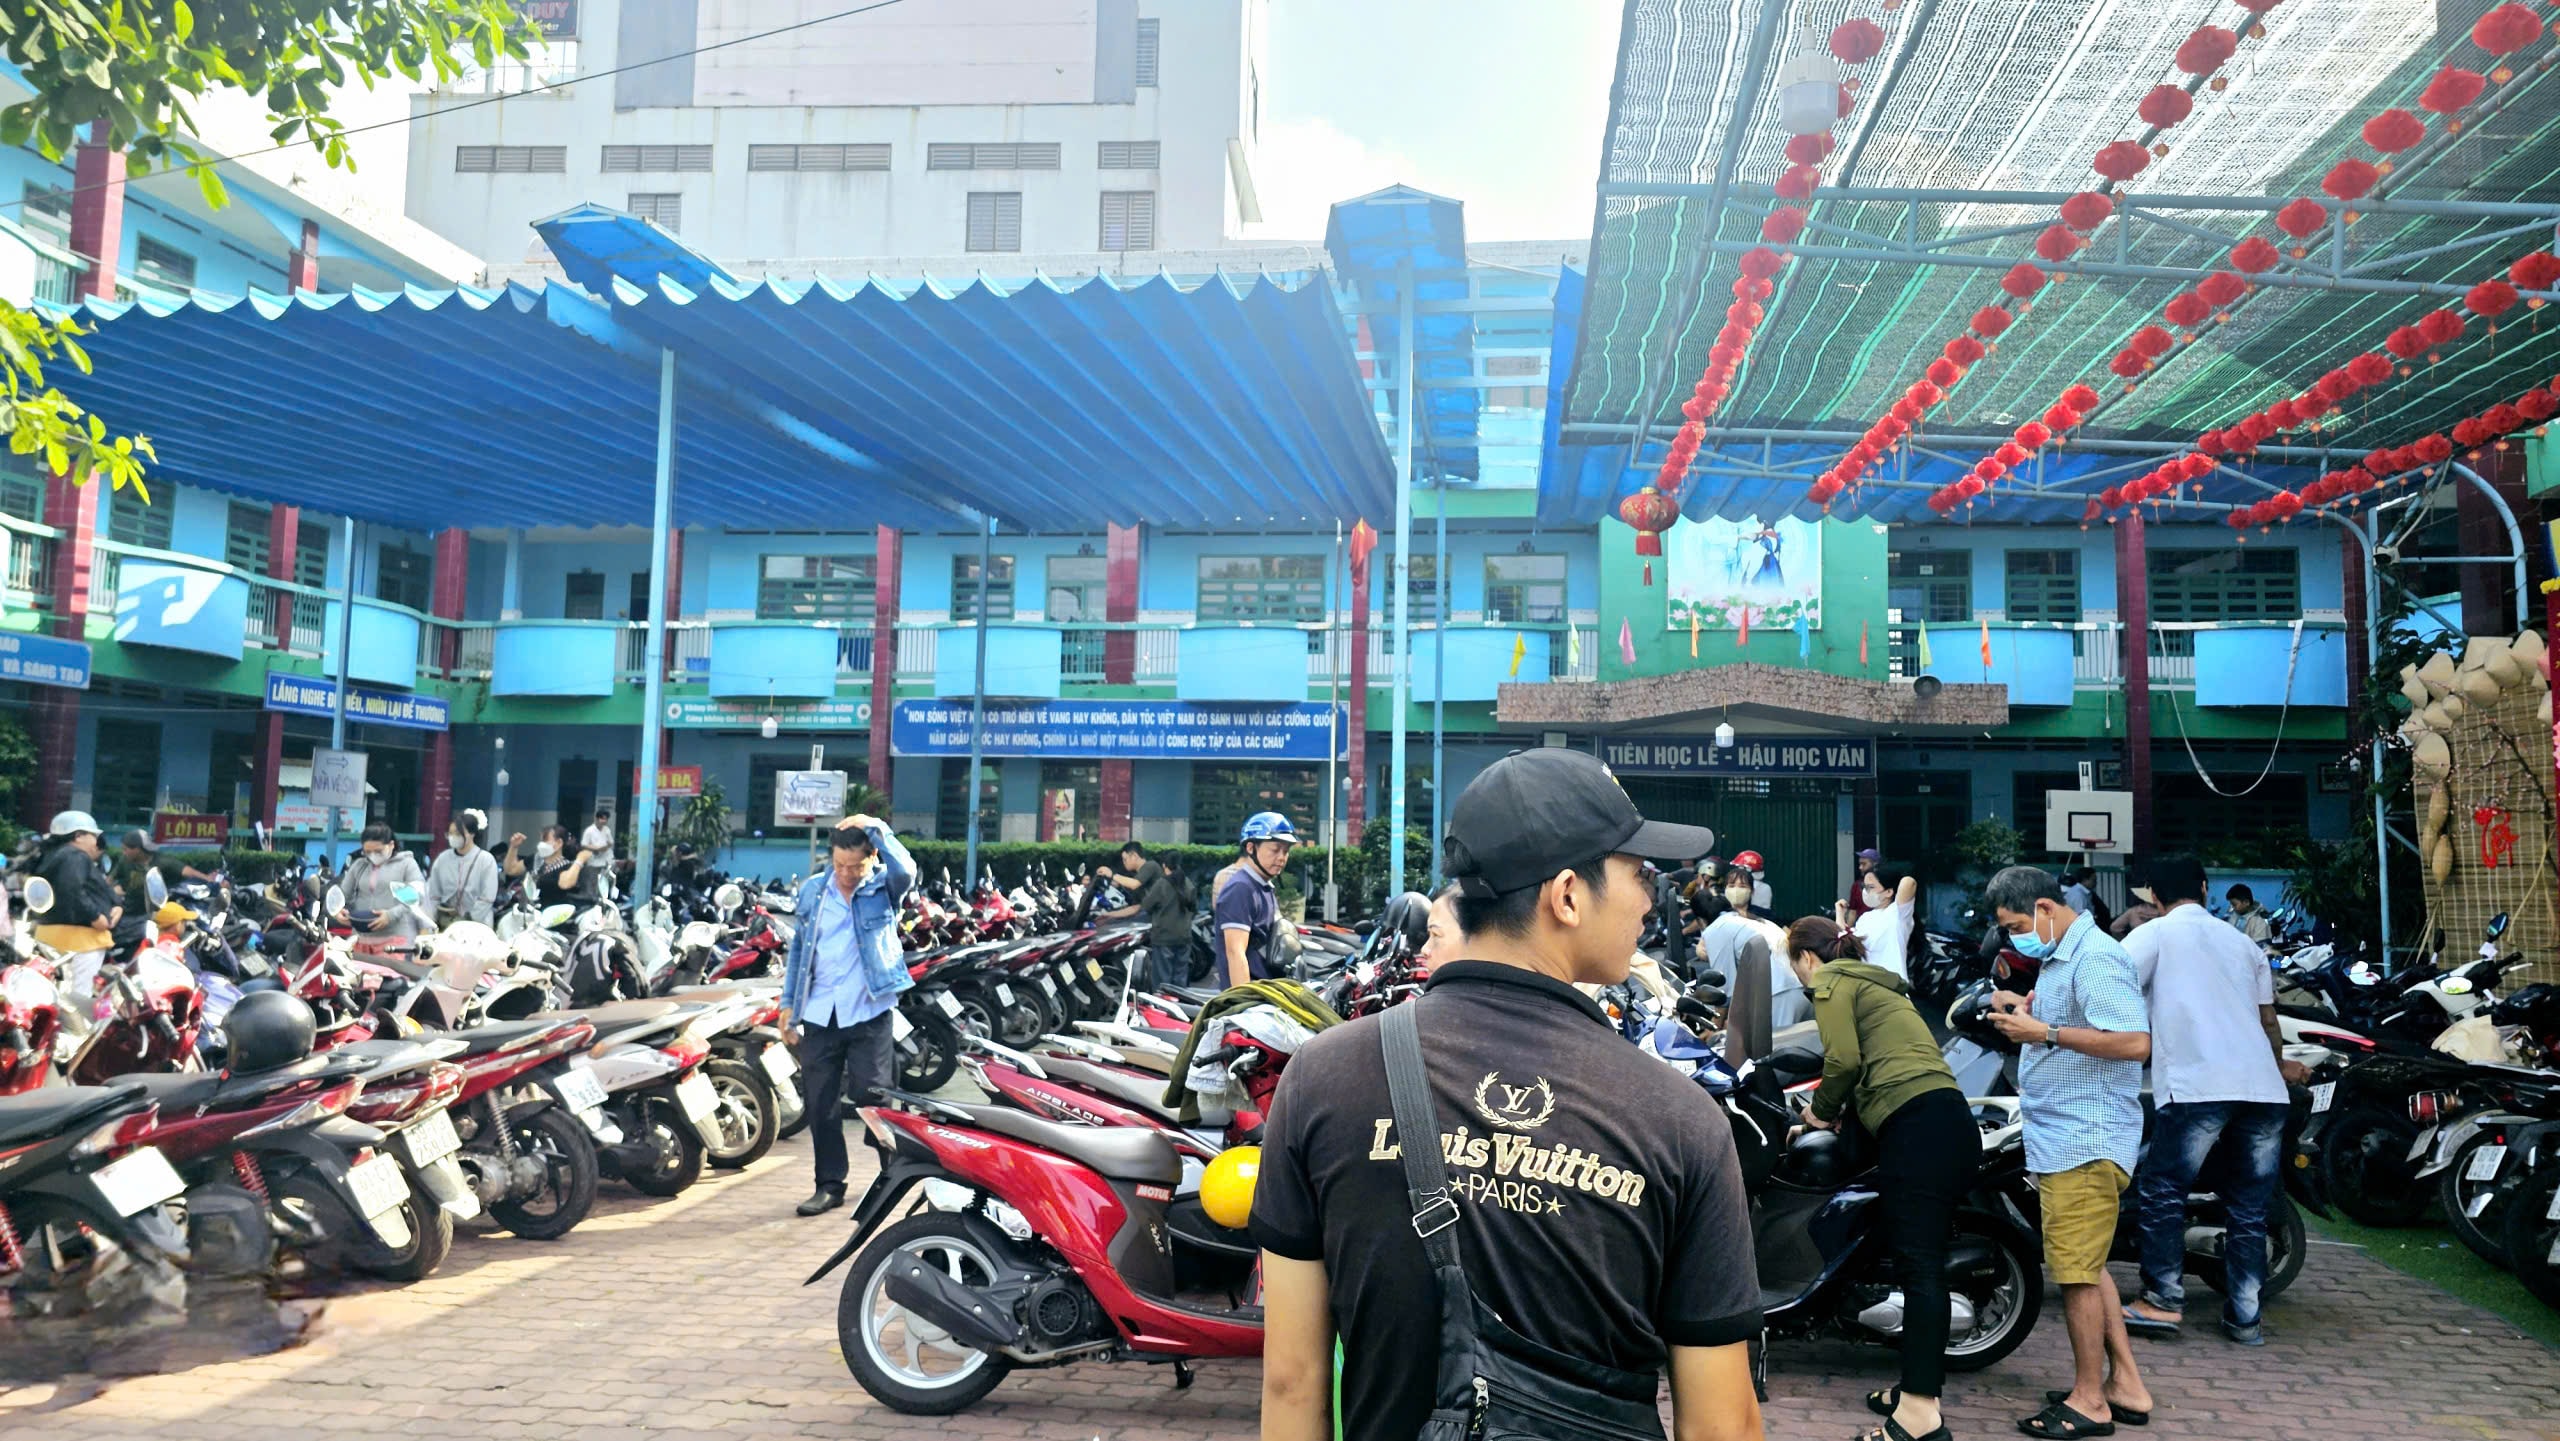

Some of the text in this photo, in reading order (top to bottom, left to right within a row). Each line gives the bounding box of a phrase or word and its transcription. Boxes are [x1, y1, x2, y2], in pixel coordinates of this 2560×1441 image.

[300, 687, 326, 707] NGHE
[415, 704, 446, 724] THƯƠNG
[927, 707, 948, 724] SÔNG
[950, 707, 967, 726] VIỆT
[1018, 708, 1035, 724] NÊN
[1050, 711, 1071, 725] VANG
[1073, 711, 1089, 725] HAY
[1090, 707, 1120, 728] KHÔNG,
[1140, 708, 1156, 728] TỘC
[1157, 708, 1176, 728] VIỆT
[1177, 712, 1195, 726] NAM
[1210, 708, 1232, 726] SÁNH
[1233, 713, 1247, 726] VAI
[1249, 709, 1264, 726] VỚI
[1266, 709, 1282, 726] CÁC
[1284, 708, 1311, 727] CƯỜNG
[1313, 708, 1332, 727] QUỐ
[948, 729, 969, 746] CHÂU
[994, 733, 1010, 746] HAY
[1012, 730, 1042, 748] KHÔNG,
[1069, 730, 1079, 747] LÀ
[1100, 730, 1117, 749] MỘT
[1166, 731, 1188, 748] CÔNG
[1190, 735, 1206, 752] HỌC
[1208, 732, 1224, 752] TẬP
[1226, 730, 1242, 748] CỦA
[1244, 732, 1261, 748] CÁC
[1607, 742, 1648, 765] TIÊN
[1654, 745, 1691, 769] HỌC
[1698, 740, 1719, 765] LỄ
[1738, 743, 1776, 770] HẬU
[1782, 747, 1821, 771] HỌC
[1826, 743, 1865, 767] VĂN
[672, 772, 693, 788] RA
[165, 818, 217, 838] LỐI RA
[1491, 1132, 1646, 1207] Vuitton
[1138, 1184, 1170, 1202] MOTUL
[1469, 1173, 1543, 1214] PARIS
